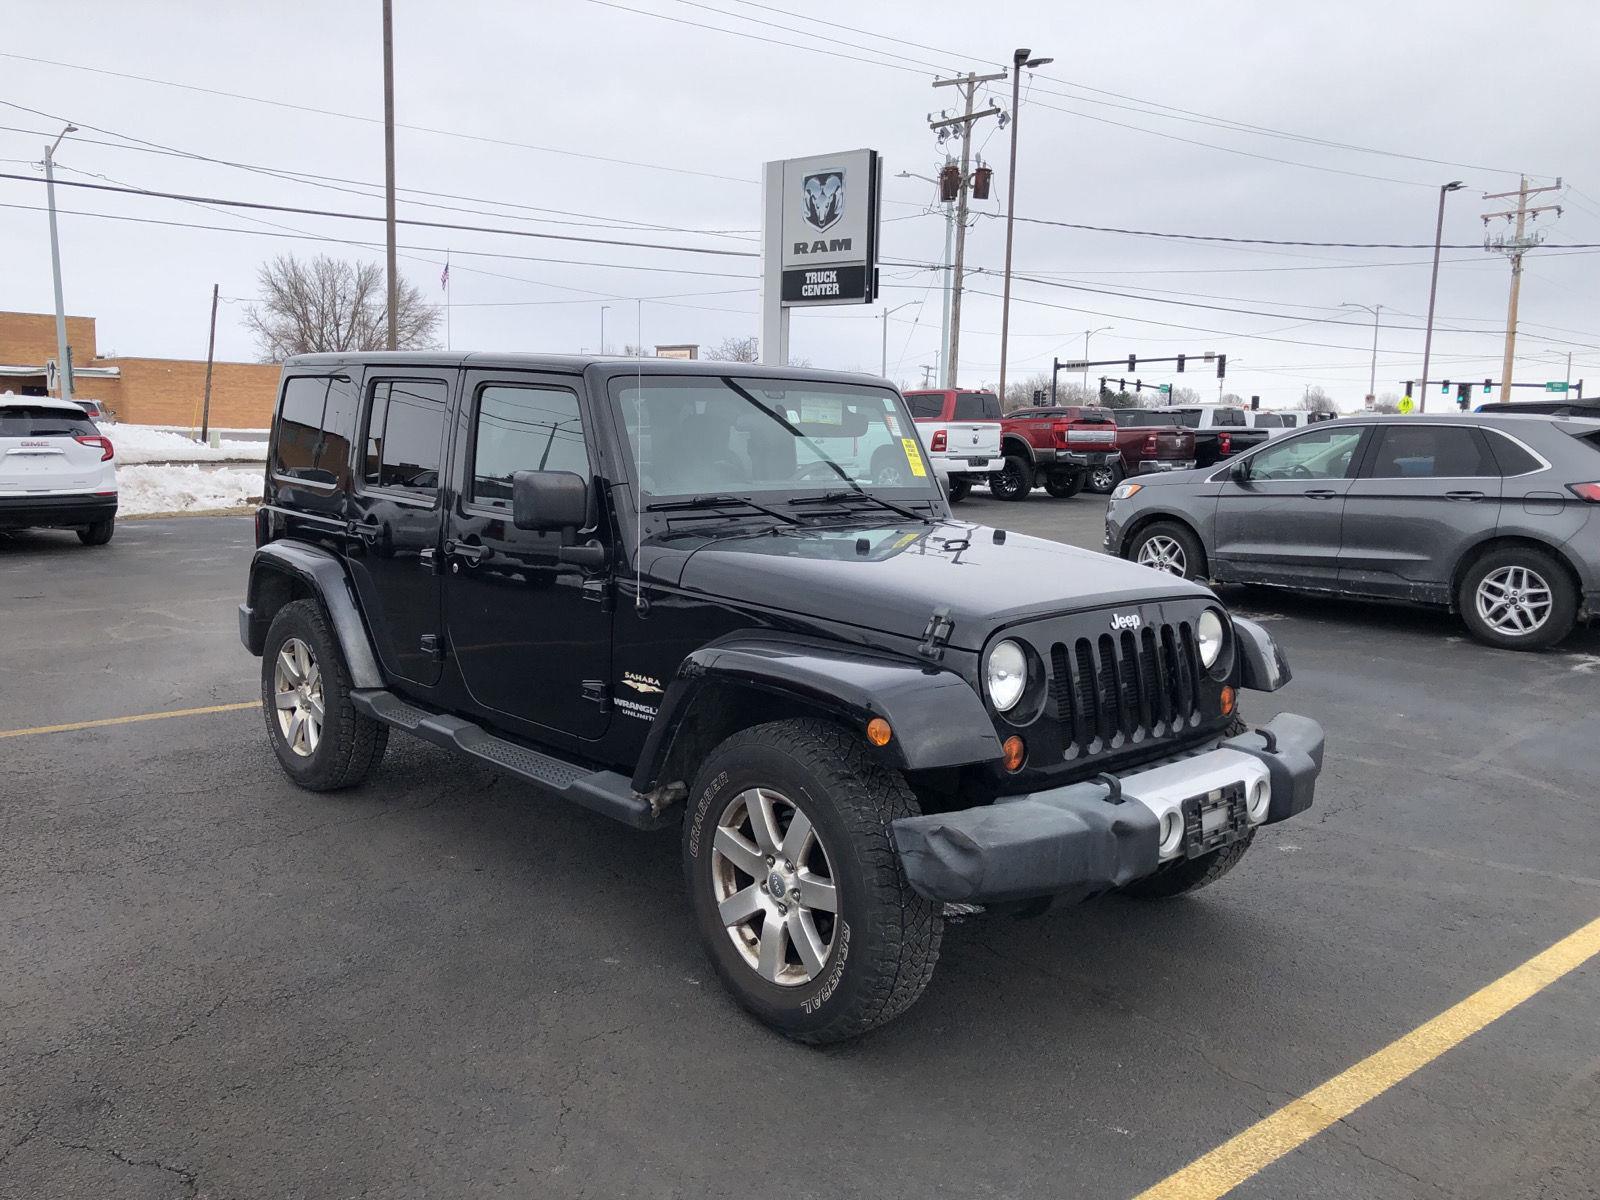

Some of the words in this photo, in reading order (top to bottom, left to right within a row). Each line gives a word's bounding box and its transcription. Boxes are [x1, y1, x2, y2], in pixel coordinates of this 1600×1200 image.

[794, 238, 852, 255] RAM
[805, 270, 837, 284] TRUCK
[802, 283, 839, 297] CENTER
[1110, 613, 1140, 630] Jeep
[624, 671, 661, 687] SAHARA
[689, 771, 729, 858] GRABBER
[801, 920, 851, 1014] GENERAL
